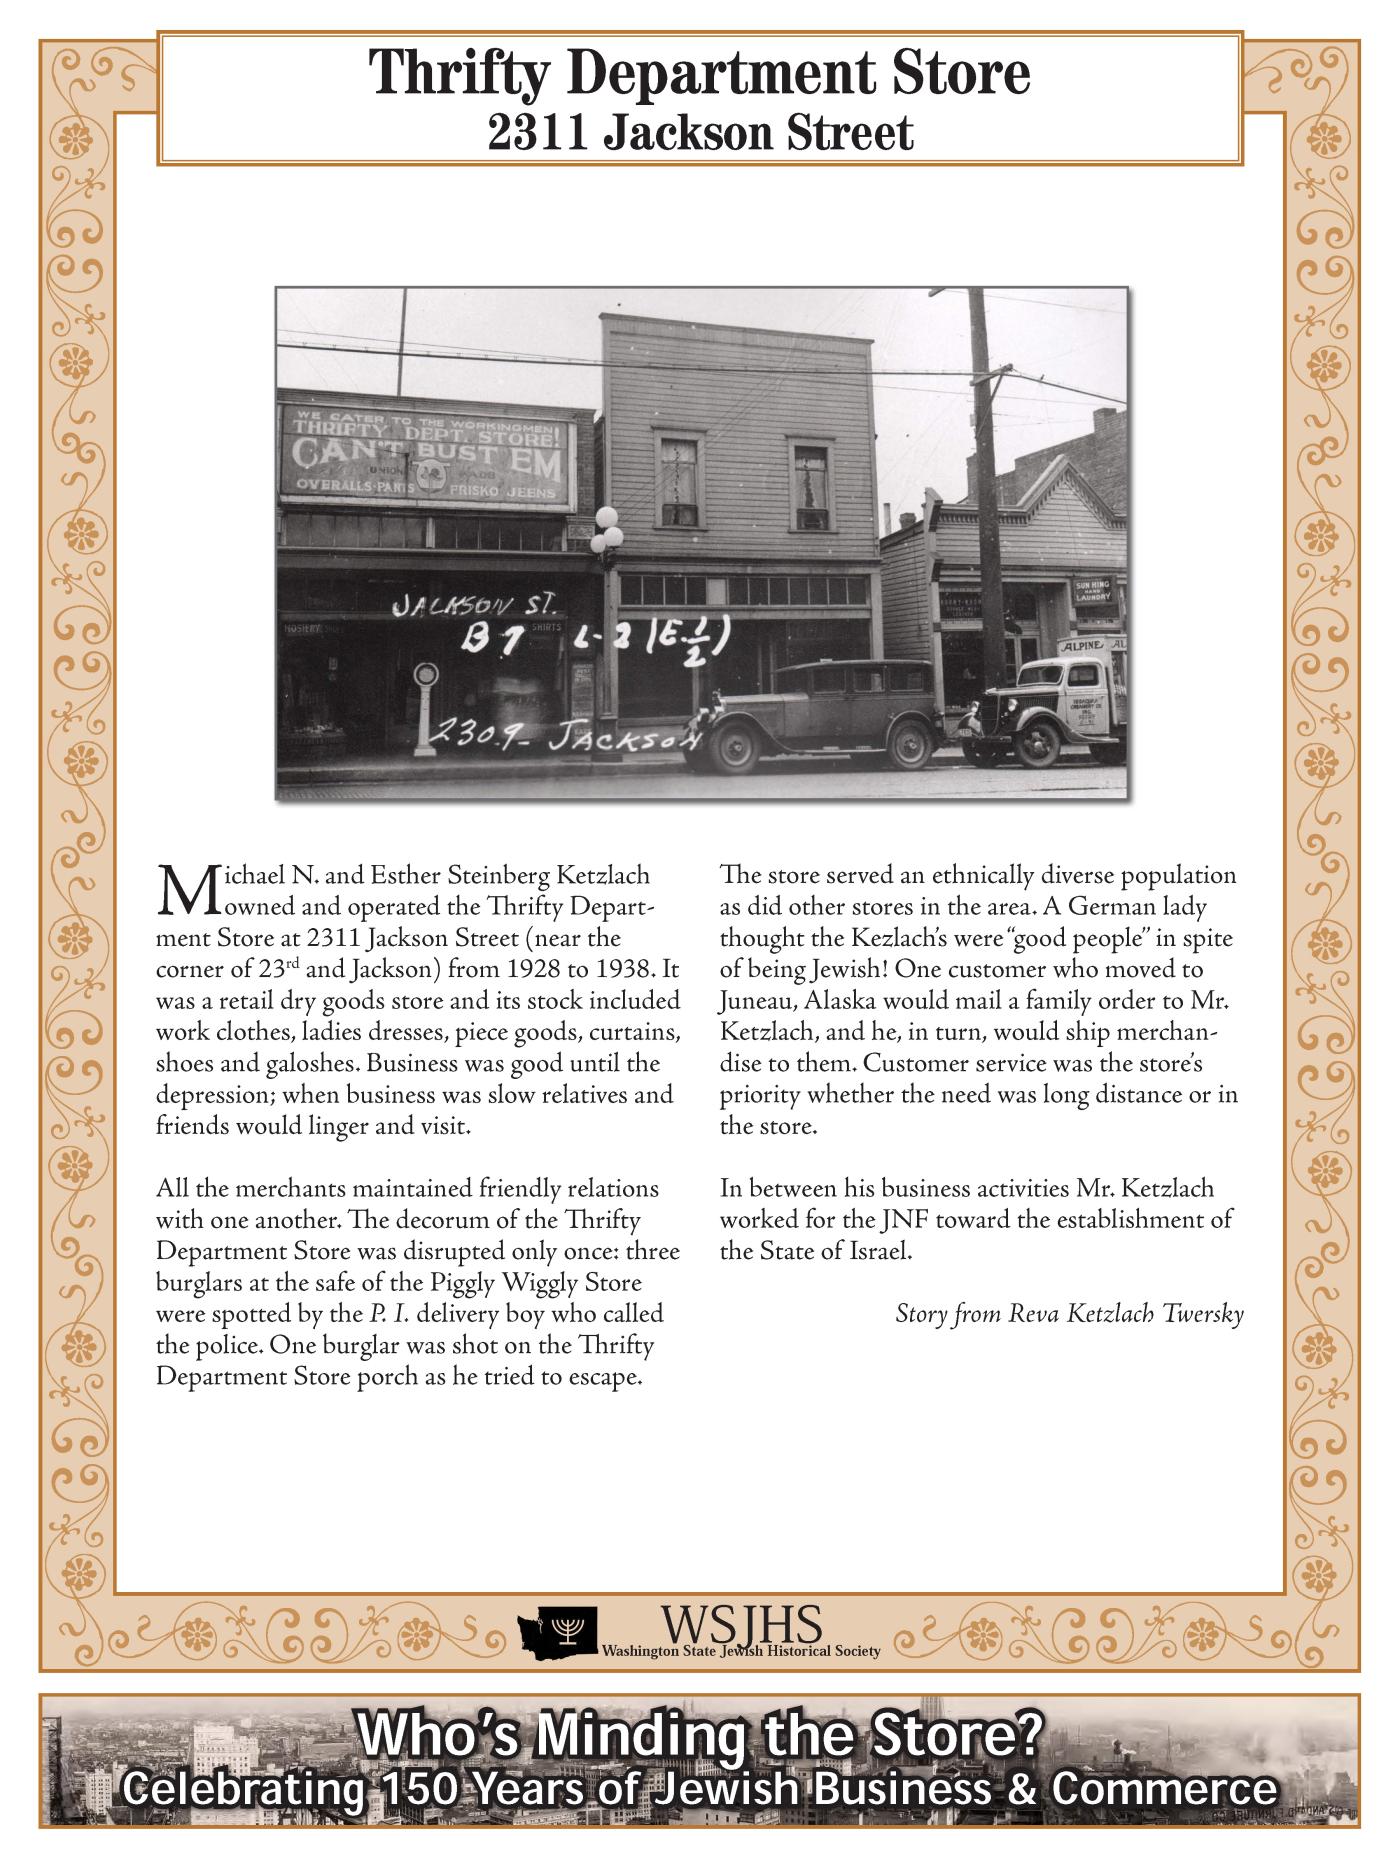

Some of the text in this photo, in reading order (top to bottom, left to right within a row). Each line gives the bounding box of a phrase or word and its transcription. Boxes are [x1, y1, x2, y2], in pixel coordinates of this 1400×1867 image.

[370, 48, 1030, 105] Thrifty Department Store
[489, 113, 913, 150] 2311 Jackson Street
[293, 419, 388, 437] THRIFTY
[298, 411, 320, 419] WE
[330, 413, 384, 423] CATER
[392, 417, 411, 425] TO
[419, 419, 445, 427] THE
[417, 442, 499, 464] BUST
[450, 485, 556, 498] FRISKO JEENS
[1076, 582, 1090, 590] SUN
[1076, 592, 1111, 601] LAUNDRY
[392, 593, 514, 618] JACKSON
[531, 623, 562, 632] SHIRTS
[1060, 640, 1104, 652] ALPINE
[548, 717, 703, 753] JACKSON
[158, 864, 649, 916] Michael N. and Esther Steinberg Ketzlach
[720, 863, 1236, 891] The store served an ethnically diverse population
[157, 966, 224, 978] corner
[231, 957, 255, 978] of
[307, 957, 345, 978] and
[349, 957, 440, 983] Jackson)
[449, 957, 500, 978] from
[509, 959, 560, 978] 1928
[568, 964, 588, 978] to
[598, 959, 656, 978] 1938.
[663, 959, 679, 978] It
[156, 1020, 680, 1048] work clothes, ladies dresses, piece goods, curtains,
[721, 1020, 1217, 1047] Ketzlach, and he, in turn, would ship merchan-
[720, 1083, 1238, 1110] priority whether the need was long distance or in
[156, 1177, 658, 1204] All the merchants maintained friendly relations
[721, 1177, 1214, 1198] In between his business activities Mr. Ketzlach
[156, 1271, 642, 1299] burglars at the safe of the Piggly Wiggly Store
[896, 1302, 1244, 1330] Story from Reva Ketzlach Twersky
[157, 1365, 642, 1392] Department Store porch as he tried to escape.
[660, 1604, 823, 1650] WSJHS
[602, 1644, 880, 1660] Washington State Jewish Historical Society
[357, 1712, 1042, 1770] Who's Minding the Store?
[123, 1771, 1277, 1816] Celebrating 150 Years of Jewish Business & Commerce
